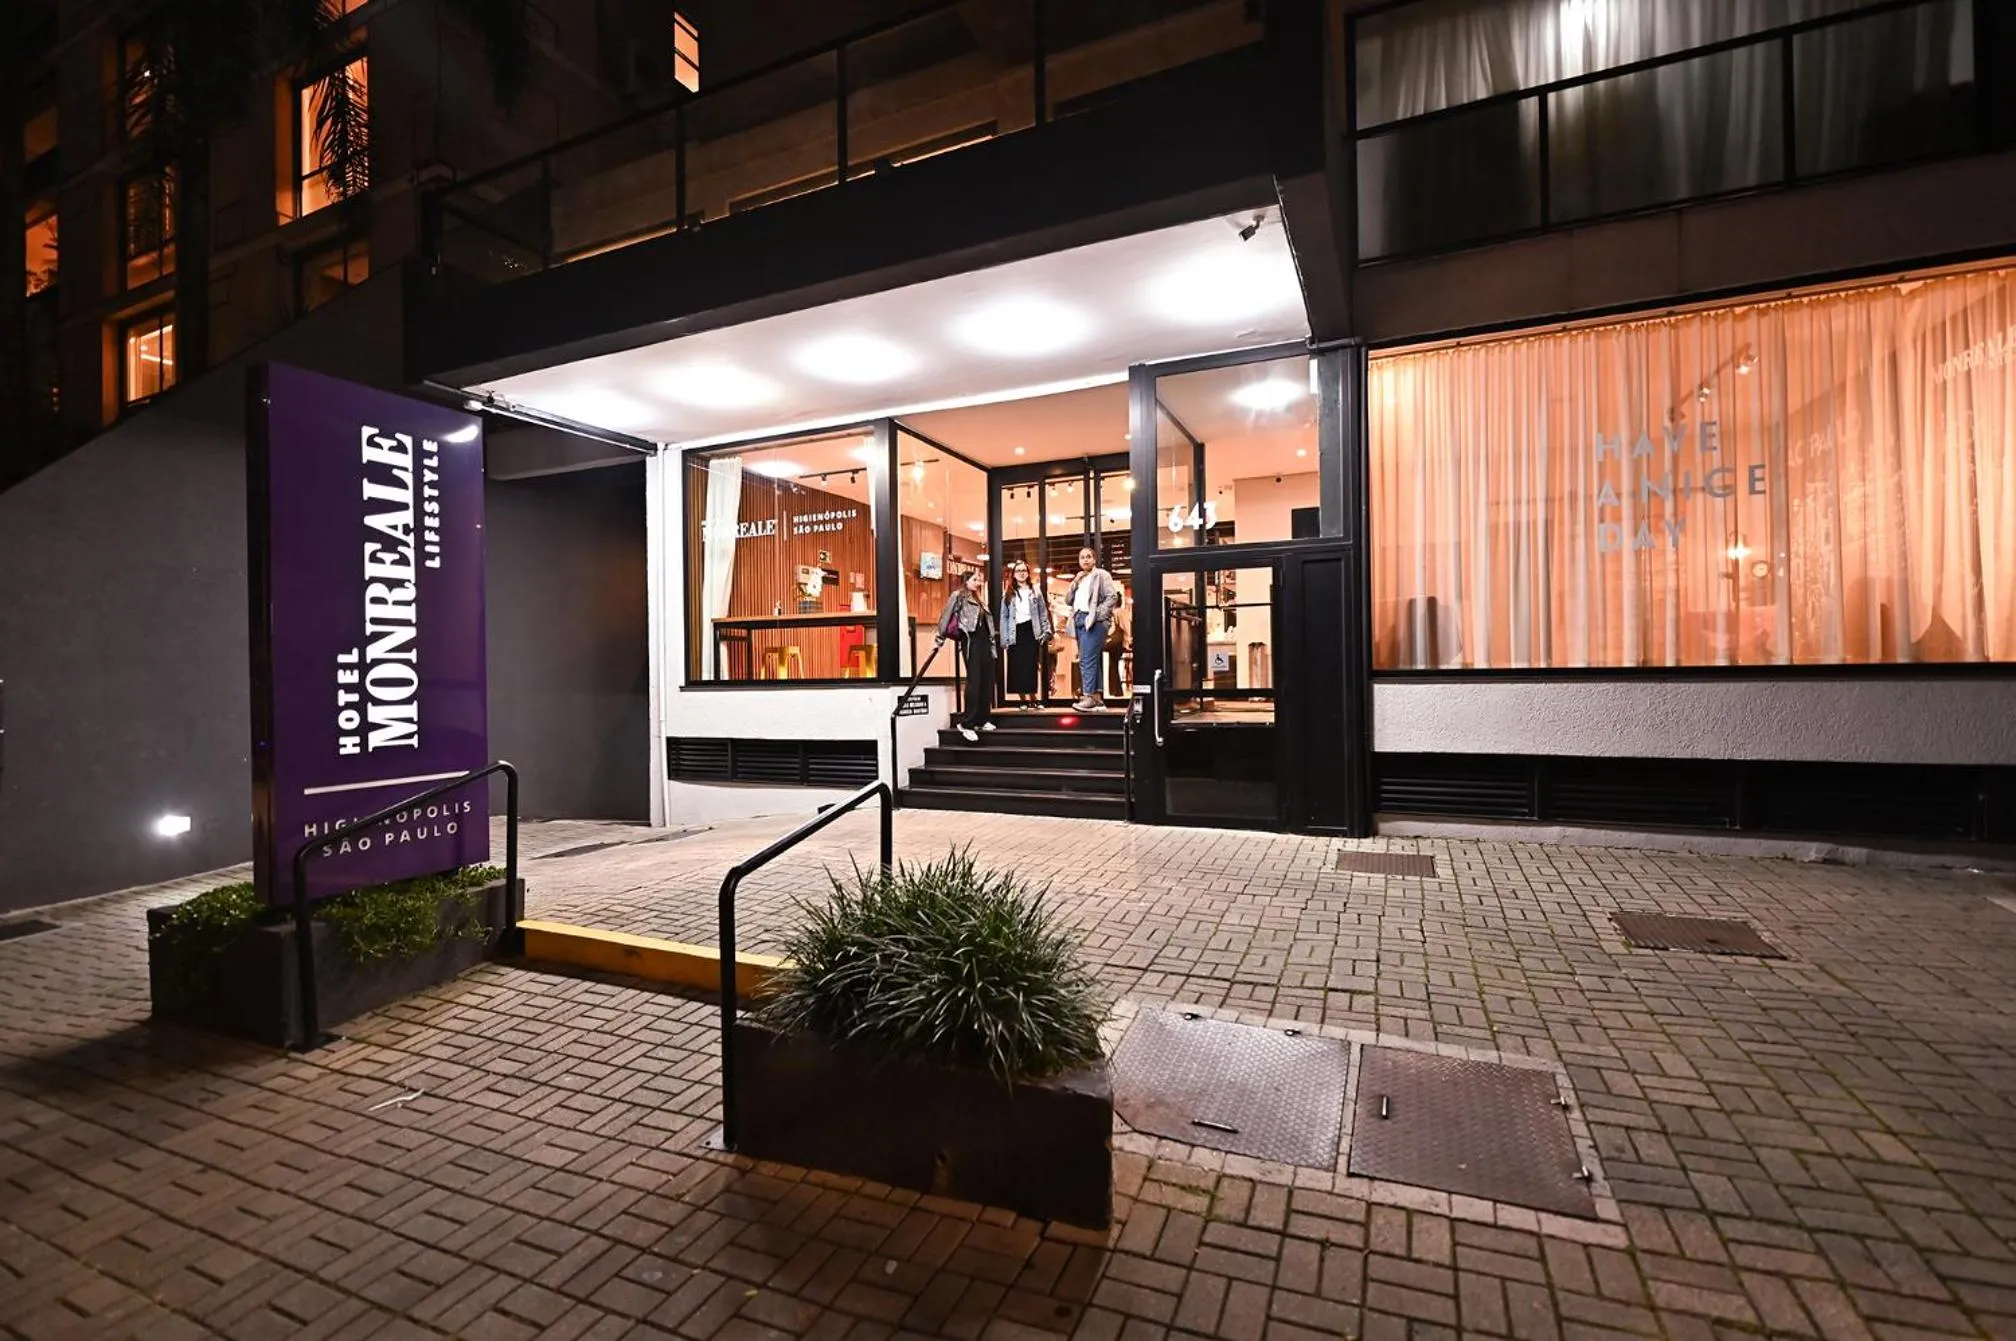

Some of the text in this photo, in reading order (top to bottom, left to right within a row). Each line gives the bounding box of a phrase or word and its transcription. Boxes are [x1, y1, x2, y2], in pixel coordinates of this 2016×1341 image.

[1595, 421, 1718, 462] HAVE
[423, 438, 442, 568] LIFESTYLE
[1597, 464, 1767, 507] A NICE
[813, 522, 844, 533] PAULO
[1598, 517, 1686, 552] DAY
[361, 425, 419, 753] MONREALE
[337, 647, 360, 755] HOTEL
[385, 822, 458, 846] PAULO
